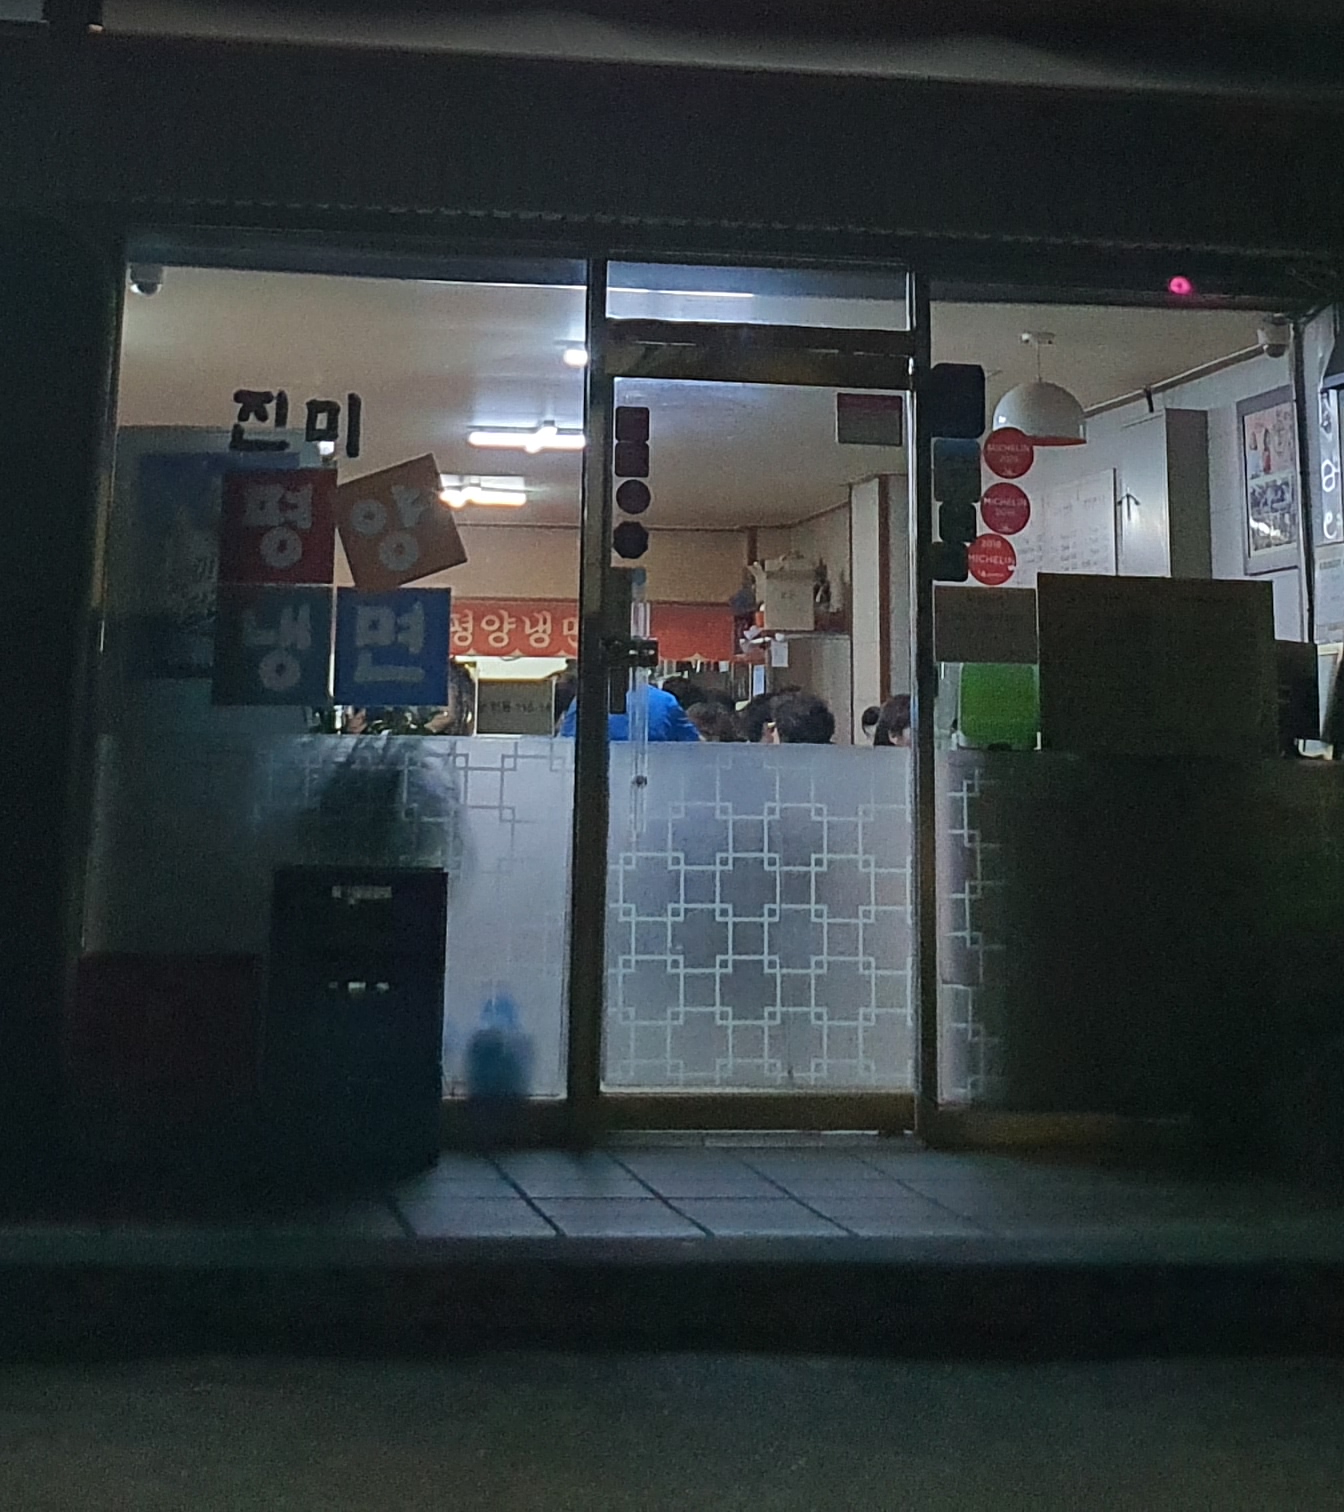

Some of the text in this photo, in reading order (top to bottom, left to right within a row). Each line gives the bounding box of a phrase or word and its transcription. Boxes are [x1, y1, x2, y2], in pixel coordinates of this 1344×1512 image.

[229, 390, 362, 458] 진미
[983, 497, 1027, 507] MICHELIN
[967, 554, 1015, 565] MICHELIN
